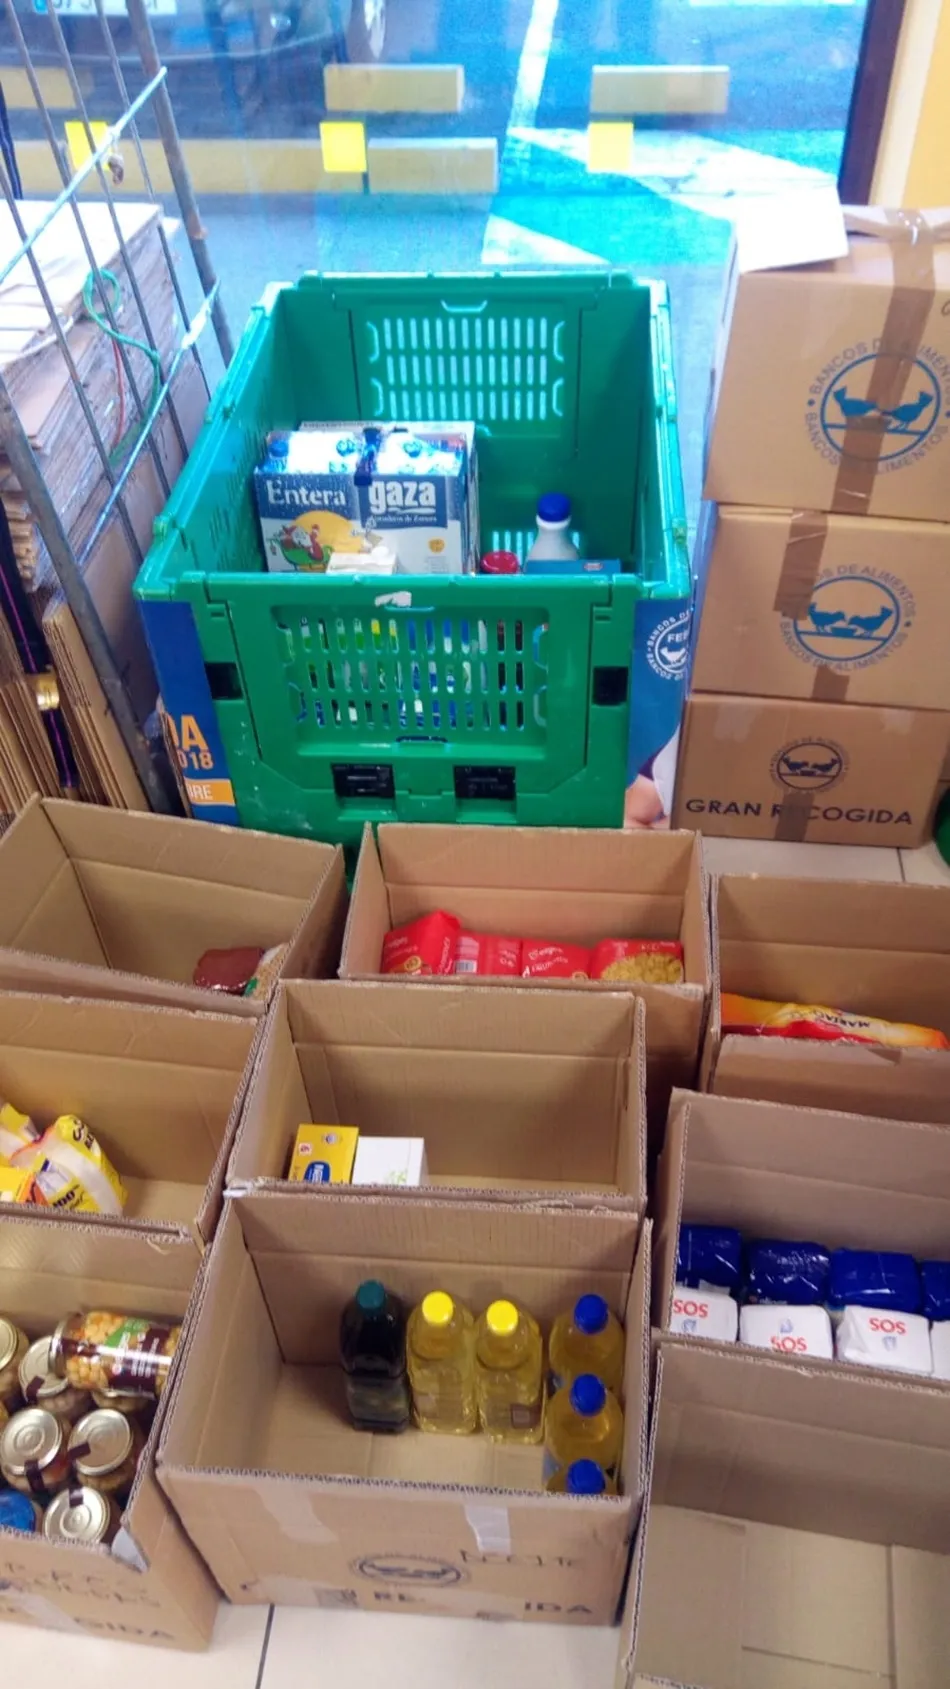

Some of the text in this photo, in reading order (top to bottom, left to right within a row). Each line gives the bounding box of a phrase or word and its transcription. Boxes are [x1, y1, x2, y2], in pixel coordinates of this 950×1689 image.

[808, 341, 868, 395] BANCOS
[266, 480, 347, 506] Entera
[368, 480, 437, 516] gaza
[685, 799, 913, 825] GRAN RCOGIDA
[673, 1299, 708, 1319] SOS
[869, 1317, 906, 1335] SOS
[770, 1335, 808, 1352] SOS
